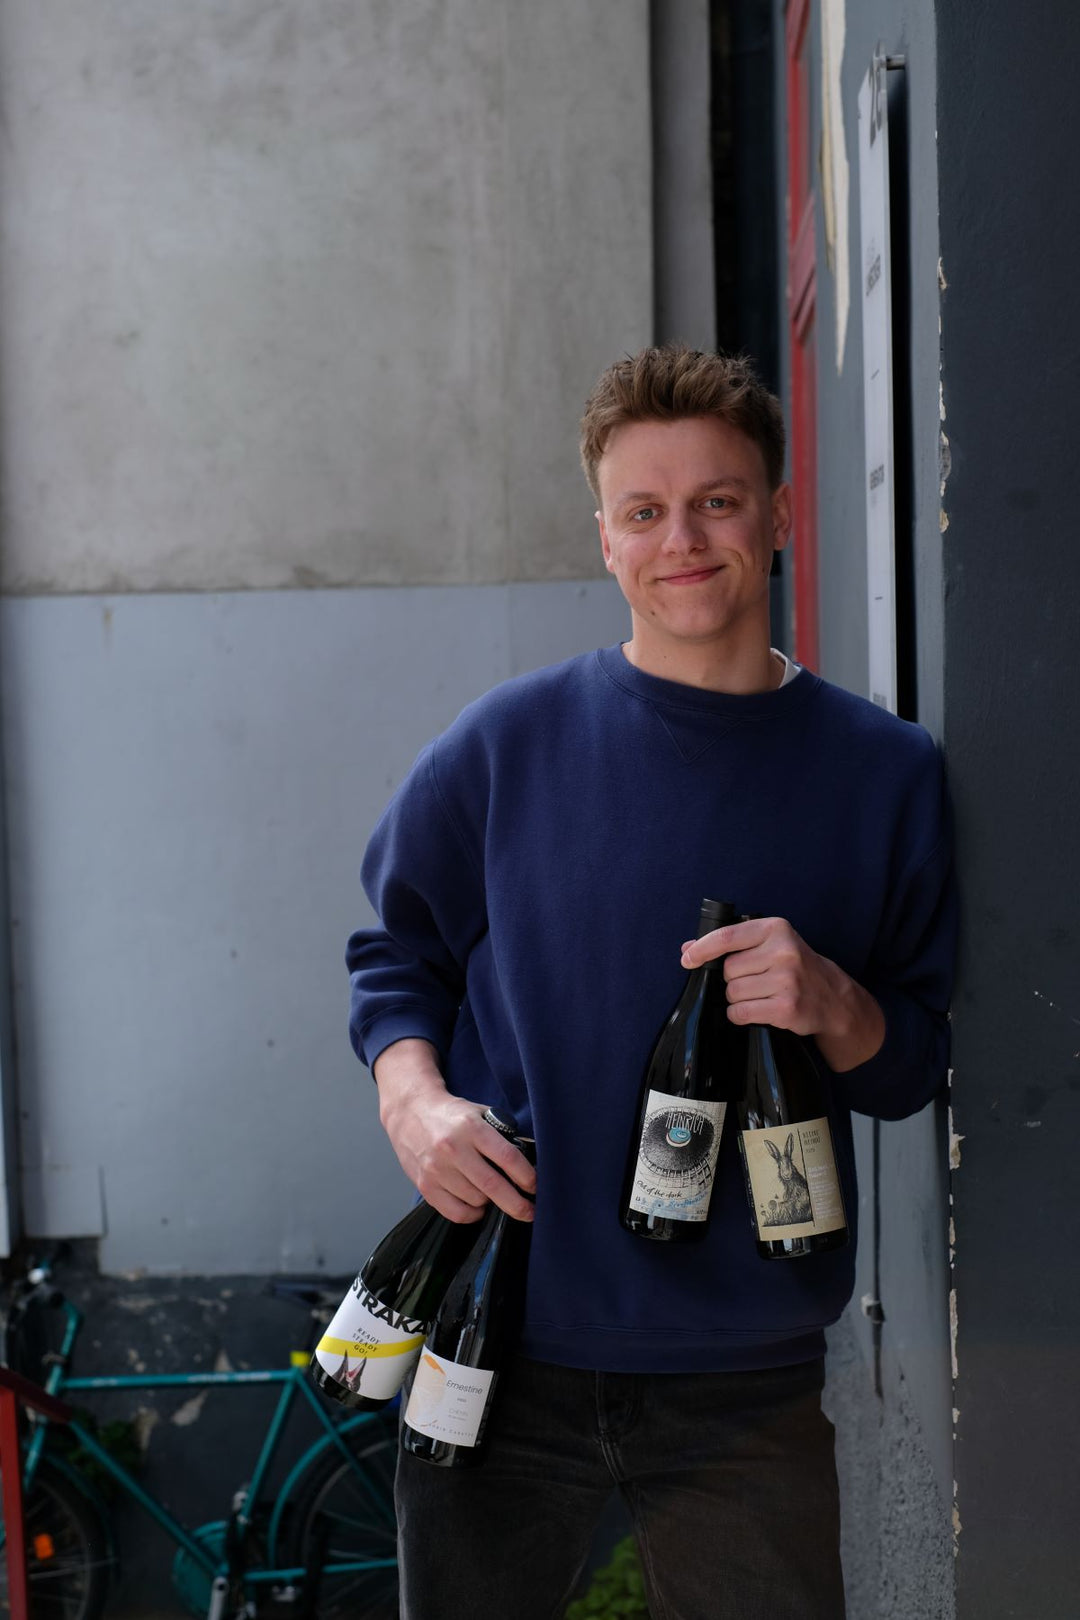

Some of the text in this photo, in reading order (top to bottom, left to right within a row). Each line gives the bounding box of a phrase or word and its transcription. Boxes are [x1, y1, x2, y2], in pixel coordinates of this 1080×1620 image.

[665, 1110, 704, 1135] HEINRICH
[353, 1277, 428, 1335] STRAKA
[352, 1333, 377, 1352] STEADY
[357, 1327, 380, 1345] READY
[353, 1343, 368, 1354] GO!
[446, 1380, 483, 1394] Ernestine
